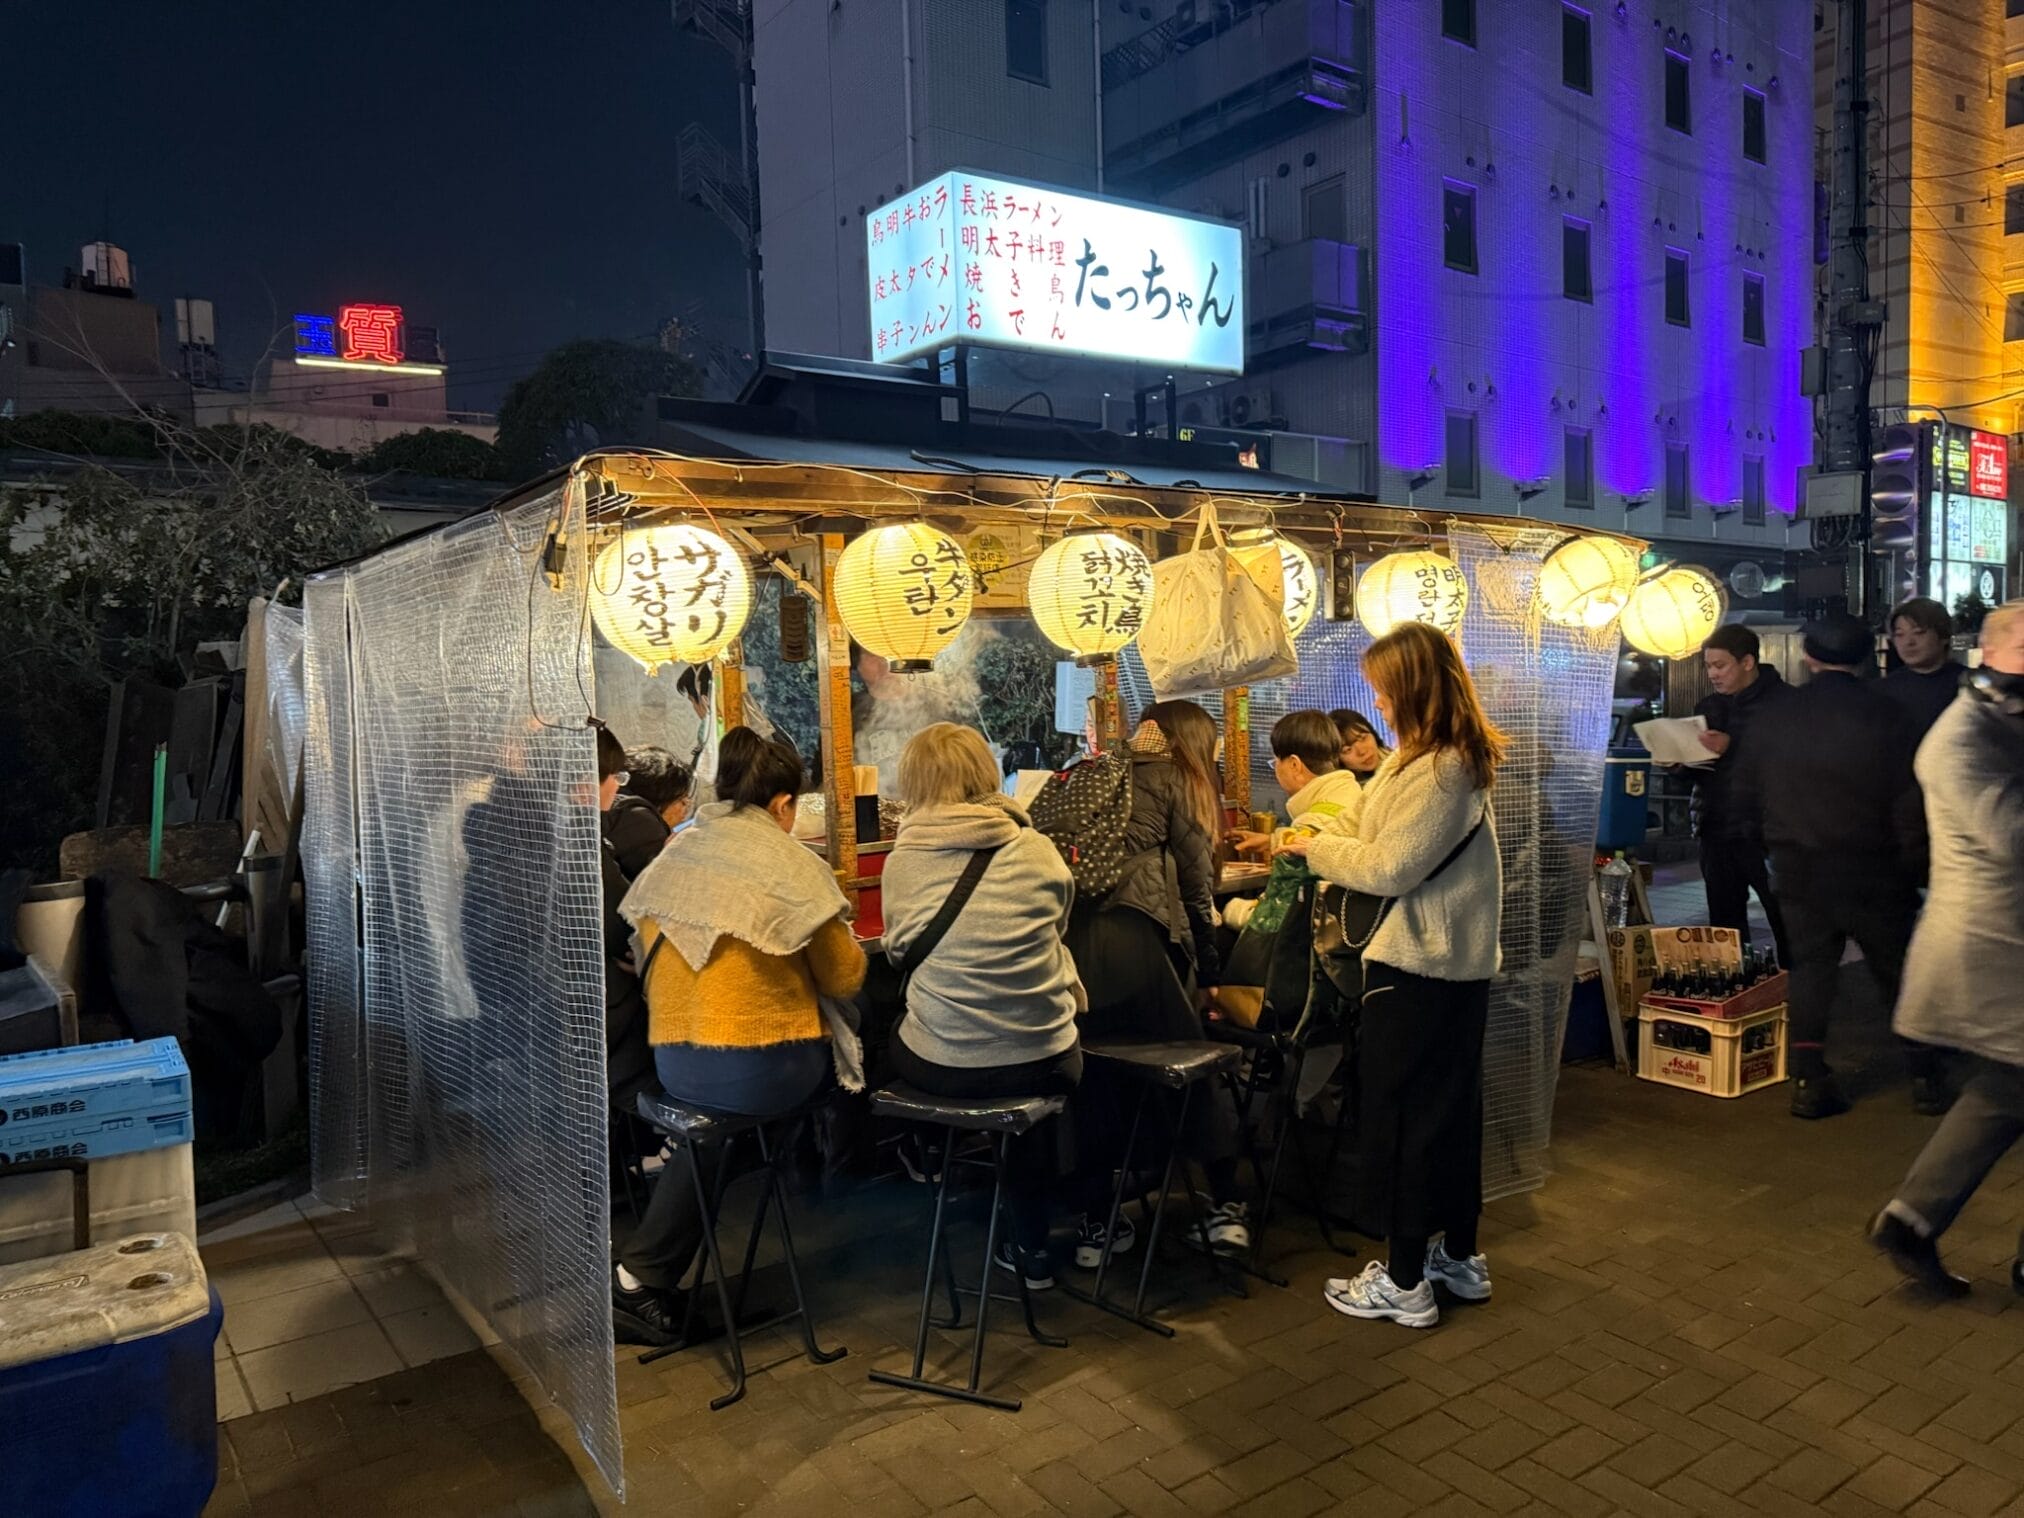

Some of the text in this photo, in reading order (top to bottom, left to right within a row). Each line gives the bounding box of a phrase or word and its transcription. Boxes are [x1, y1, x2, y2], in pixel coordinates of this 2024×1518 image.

[960, 183, 1063, 228] 長浜ラーメン
[960, 225, 1066, 267] 明太子料理
[886, 209, 904, 347] 明太子
[902, 202, 920, 345] 牛タン
[918, 195, 937, 337] おでん
[933, 184, 952, 332] ラーメン
[964, 260, 1065, 304] 焼き鳥
[1075, 237, 1235, 328] たっちゃん
[966, 296, 1066, 340] おでん
[626, 545, 677, 647] 안창살
[898, 552, 940, 616] 우탄
[1105, 547, 1152, 639] 焼き鳥
[12, 1099, 86, 1121] 西原商会
